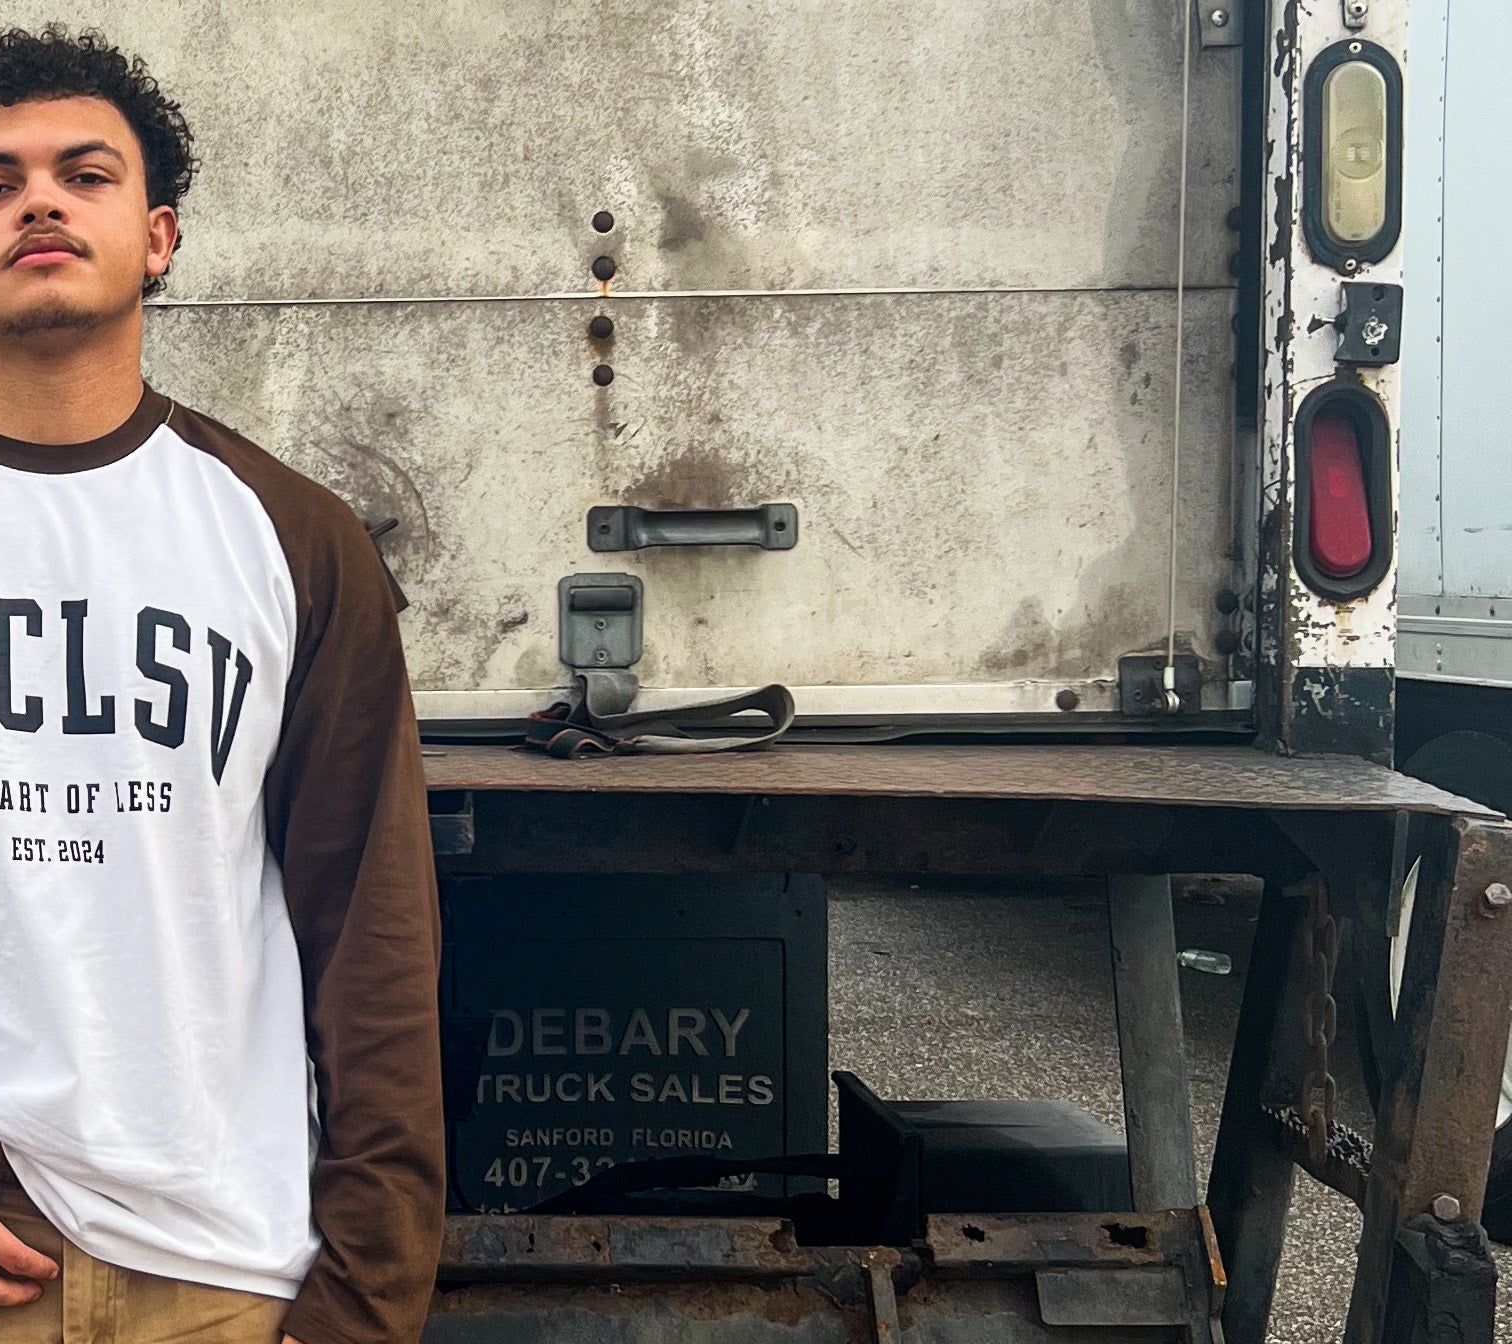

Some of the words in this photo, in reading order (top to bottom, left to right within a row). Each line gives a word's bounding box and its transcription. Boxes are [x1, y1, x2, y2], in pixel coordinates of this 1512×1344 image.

[66, 782, 100, 814] OF
[115, 781, 173, 814] LESS
[12, 837, 52, 863] EST.
[58, 839, 105, 865] 2024
[487, 1008, 751, 1058] DEBARY
[630, 1073, 774, 1106] SALES
[506, 1128, 615, 1148] SANFORD
[632, 1128, 734, 1149] FLORIDA
